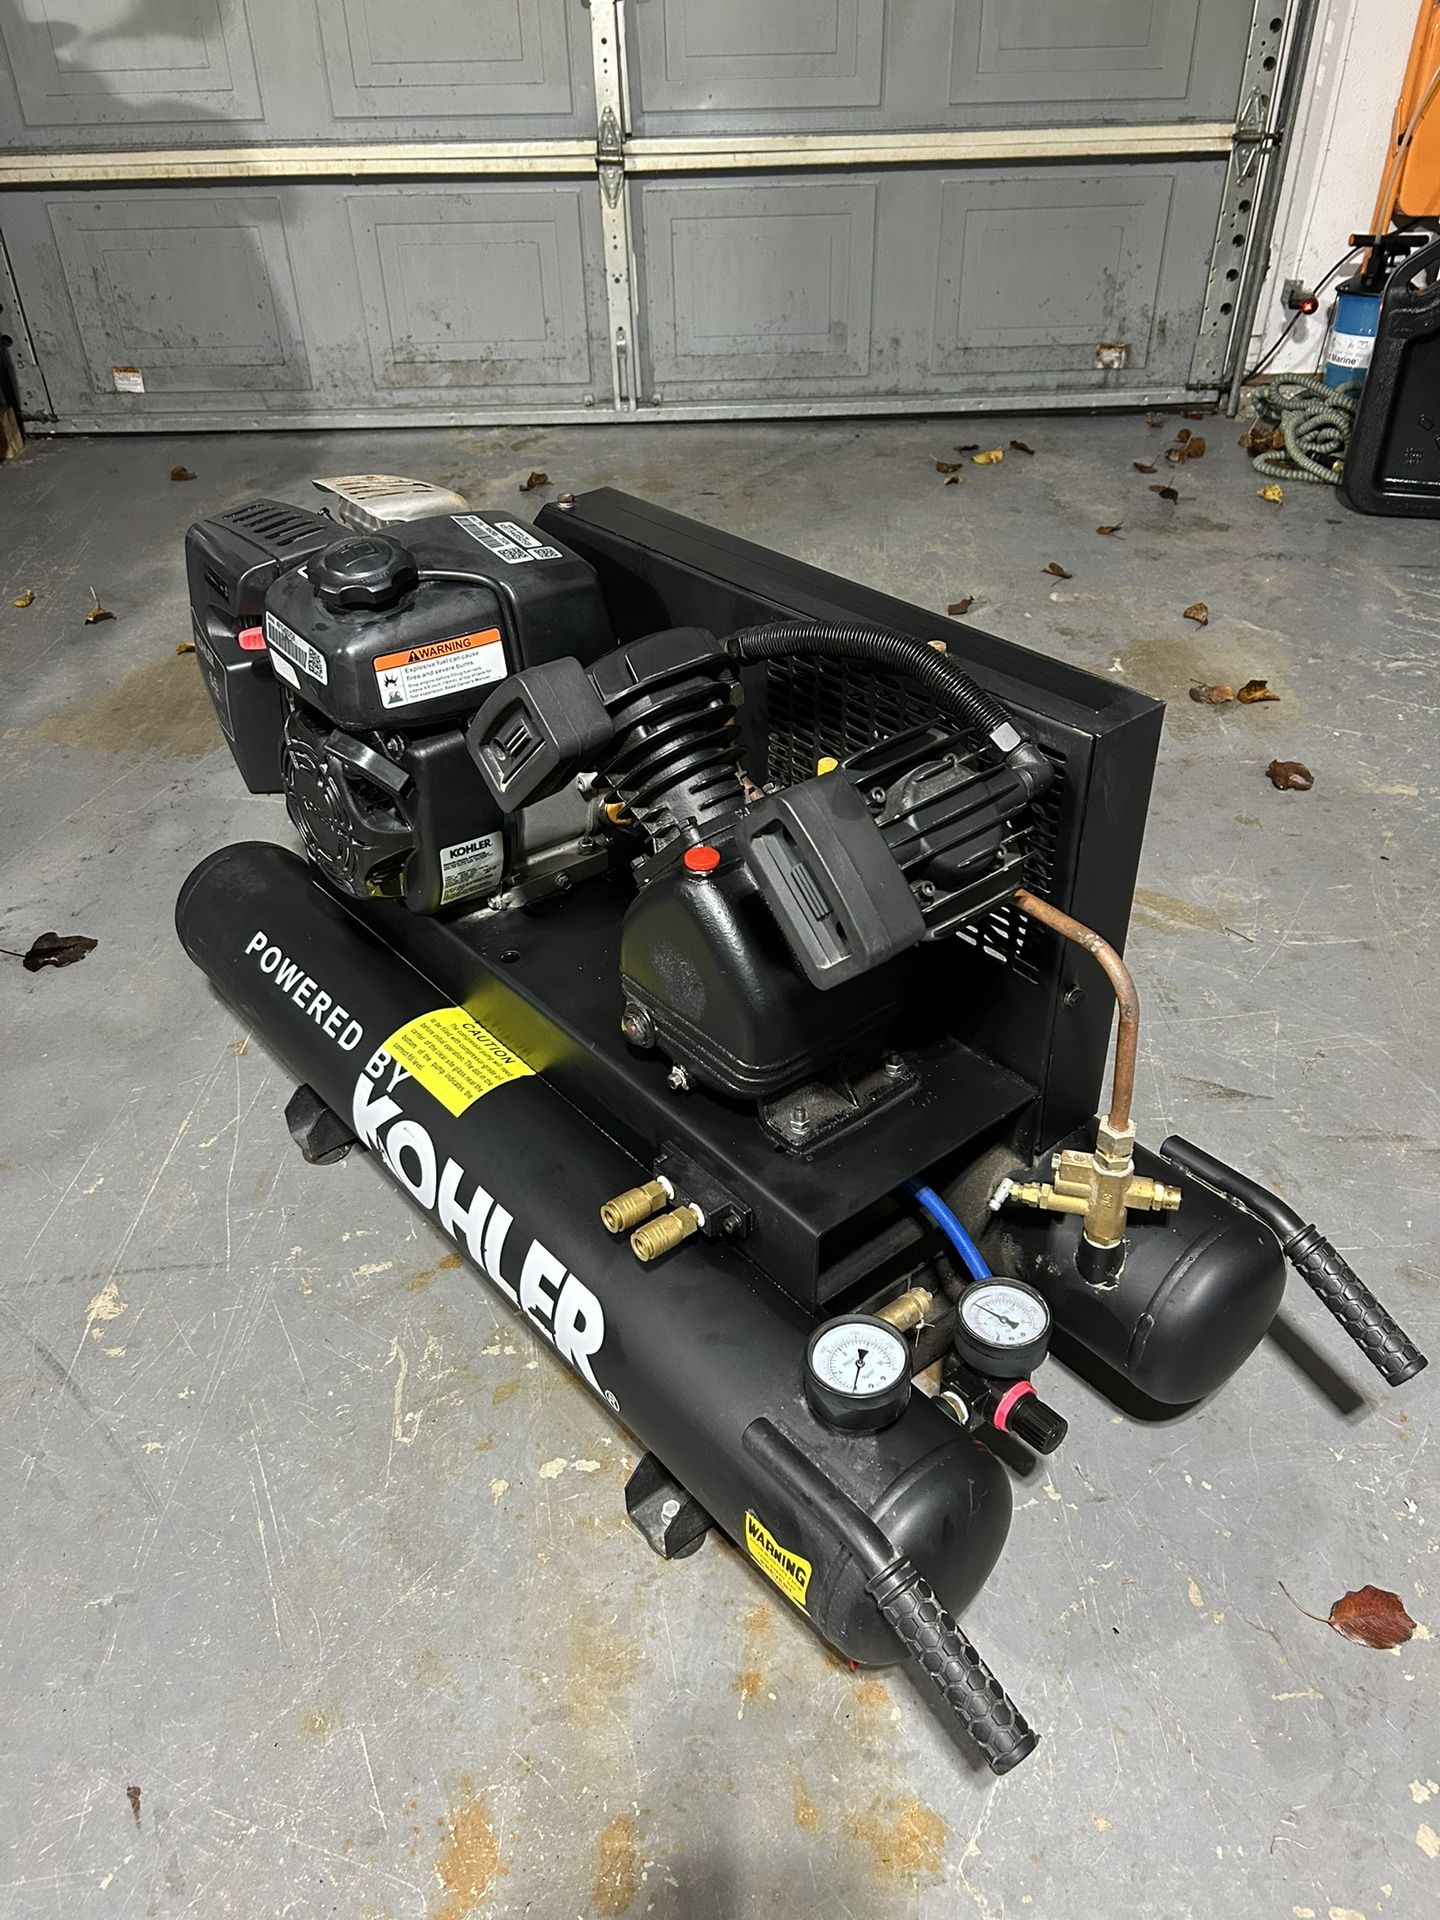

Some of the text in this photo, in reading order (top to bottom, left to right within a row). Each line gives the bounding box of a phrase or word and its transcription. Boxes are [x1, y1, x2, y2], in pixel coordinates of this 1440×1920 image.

[1331, 353, 1357, 365] Marine
[404, 662, 435, 674] Explosive
[461, 651, 479, 659] cause
[418, 638, 471, 659] WARNING
[435, 665, 455, 674] severe
[450, 839, 491, 859] KOHLER
[244, 930, 413, 1093] POWERED BY
[393, 1042, 409, 1057] correct
[406, 1053, 415, 1061] fill
[401, 1034, 417, 1049] bottom
[430, 1062, 446, 1075] pump
[444, 1073, 465, 1092] indicates
[410, 1029, 425, 1040] center
[435, 1050, 448, 1060] clear
[445, 1059, 455, 1067] site
[451, 1066, 467, 1078] glass
[464, 1076, 477, 1086] near
[420, 1022, 435, 1035] before
[432, 1034, 447, 1044] initial
[443, 1043, 465, 1062] operation.
[440, 1027, 453, 1037] filled
[450, 1036, 461, 1044] with
[458, 1043, 484, 1064] compressor
[480, 1062, 497, 1075] grade
[457, 1030, 482, 1050] compressor
[478, 1049, 494, 1061] pump
[500, 1067, 514, 1077] need
[462, 1022, 516, 1064] CAUTION
[353, 1072, 605, 1400] KOHLER
[748, 1517, 807, 1588] WARNING
